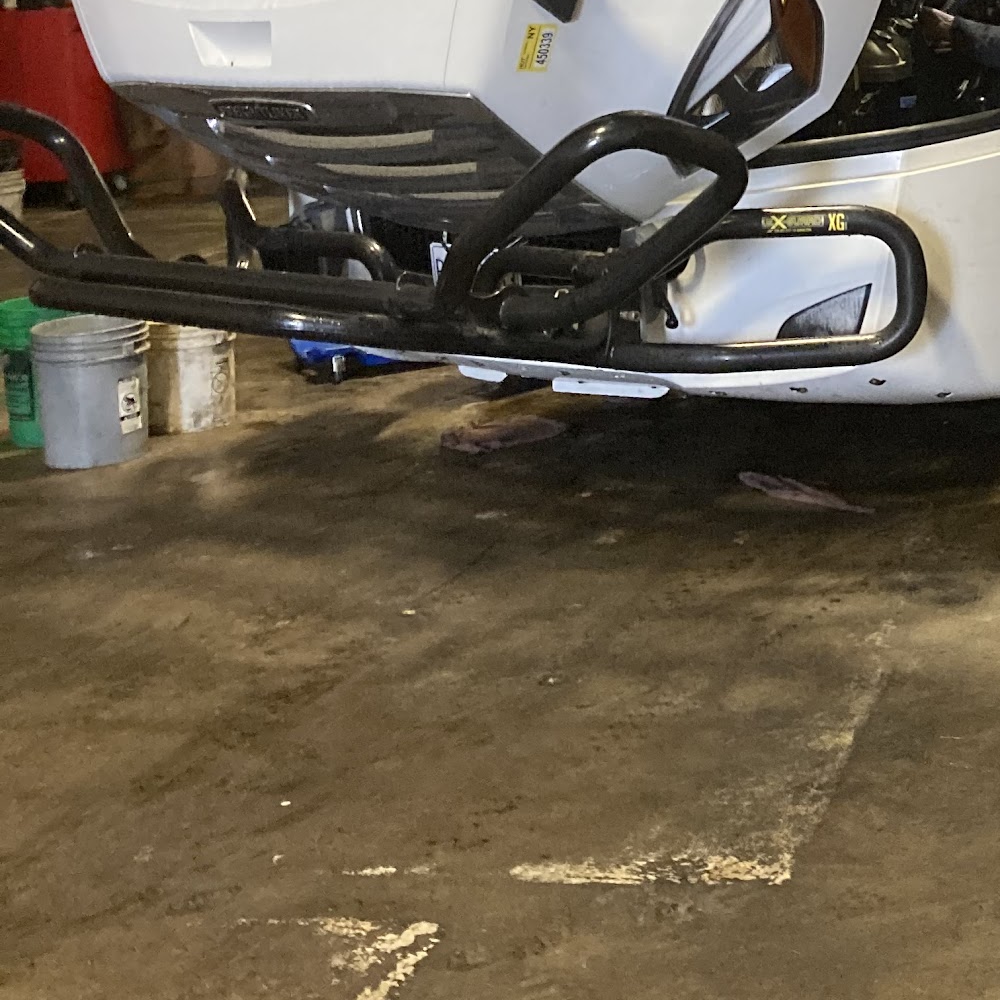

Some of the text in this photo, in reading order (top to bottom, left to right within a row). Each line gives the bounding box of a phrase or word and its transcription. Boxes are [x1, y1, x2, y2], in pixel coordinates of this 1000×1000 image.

[527, 26, 536, 39] NY
[536, 32, 554, 65] 450339
[828, 213, 845, 231] XG
